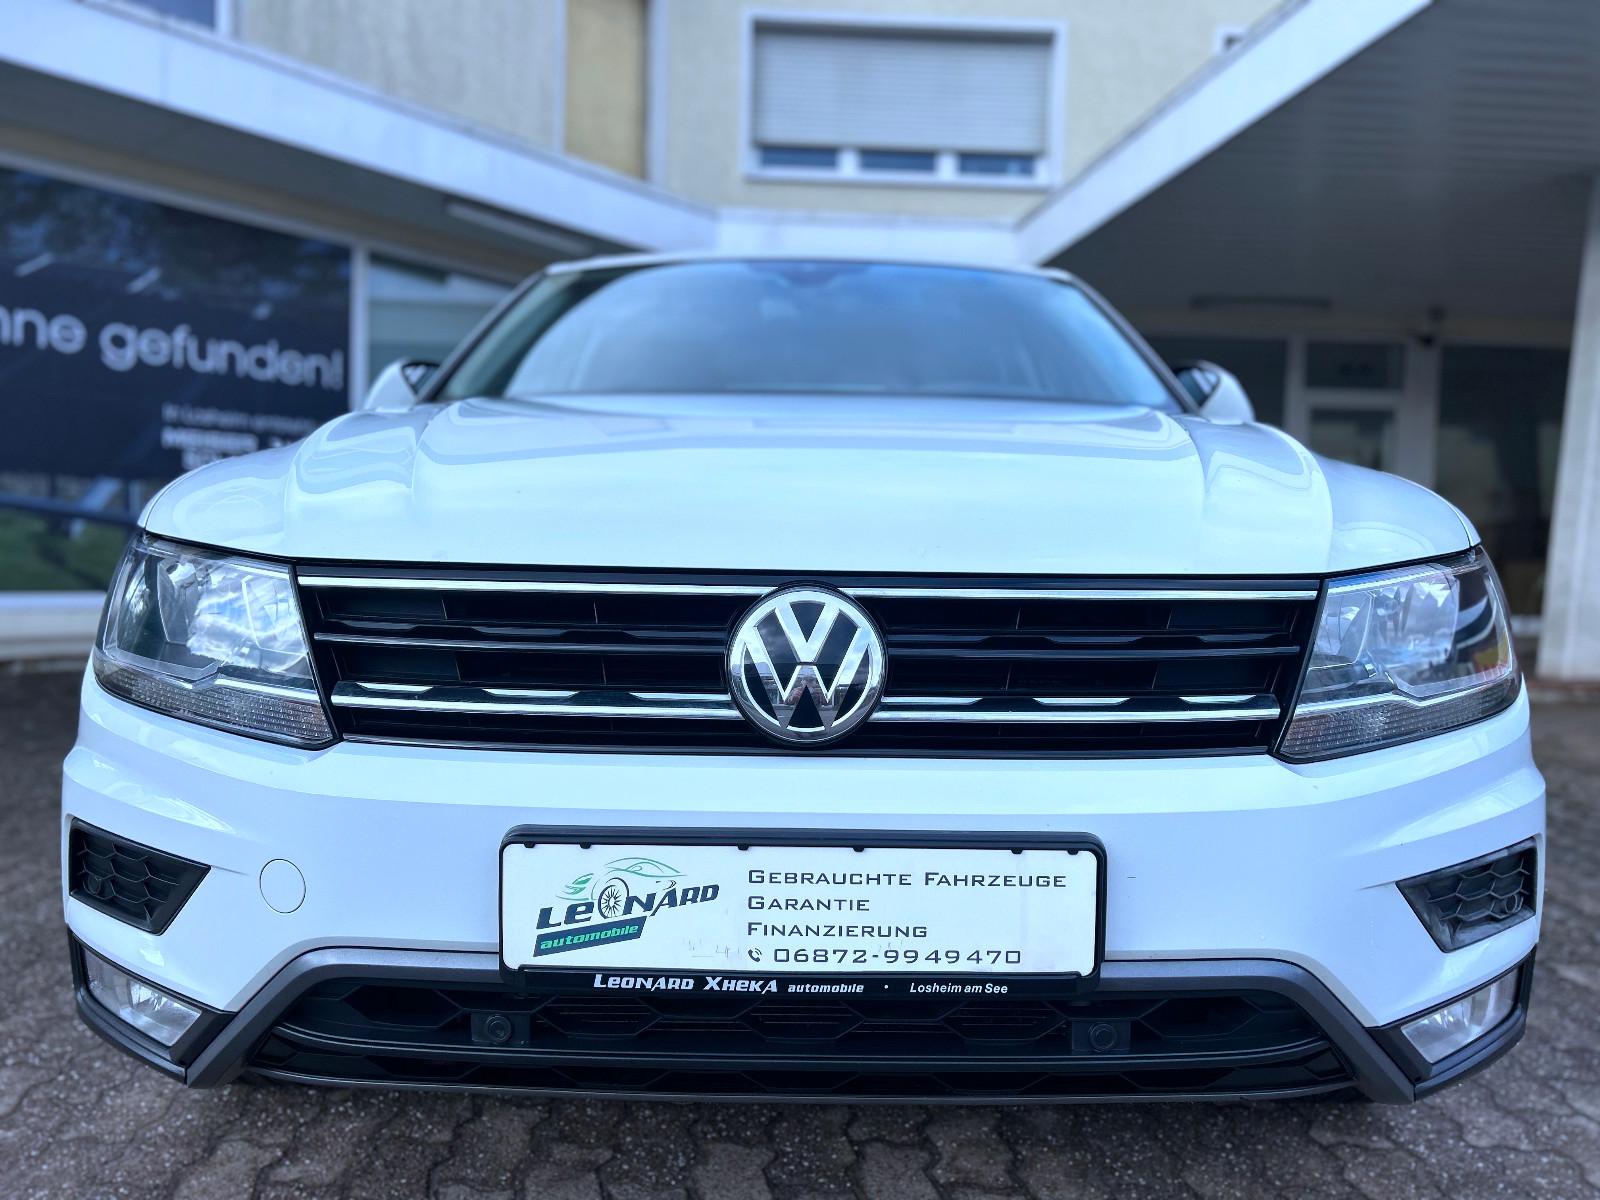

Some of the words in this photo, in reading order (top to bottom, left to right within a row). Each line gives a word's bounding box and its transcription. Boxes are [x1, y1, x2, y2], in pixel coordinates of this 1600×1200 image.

[748, 869, 912, 886] GEBRAUCHTE
[924, 872, 1066, 888] FAHRZEUGE
[747, 895, 870, 911] GARANTIE
[540, 924, 639, 950] automobile
[747, 922, 928, 938] FINANZIERUNG
[787, 983, 864, 994] automobile
[909, 982, 962, 994] Losheim
[964, 984, 983, 994] am
[984, 983, 1008, 995] See
